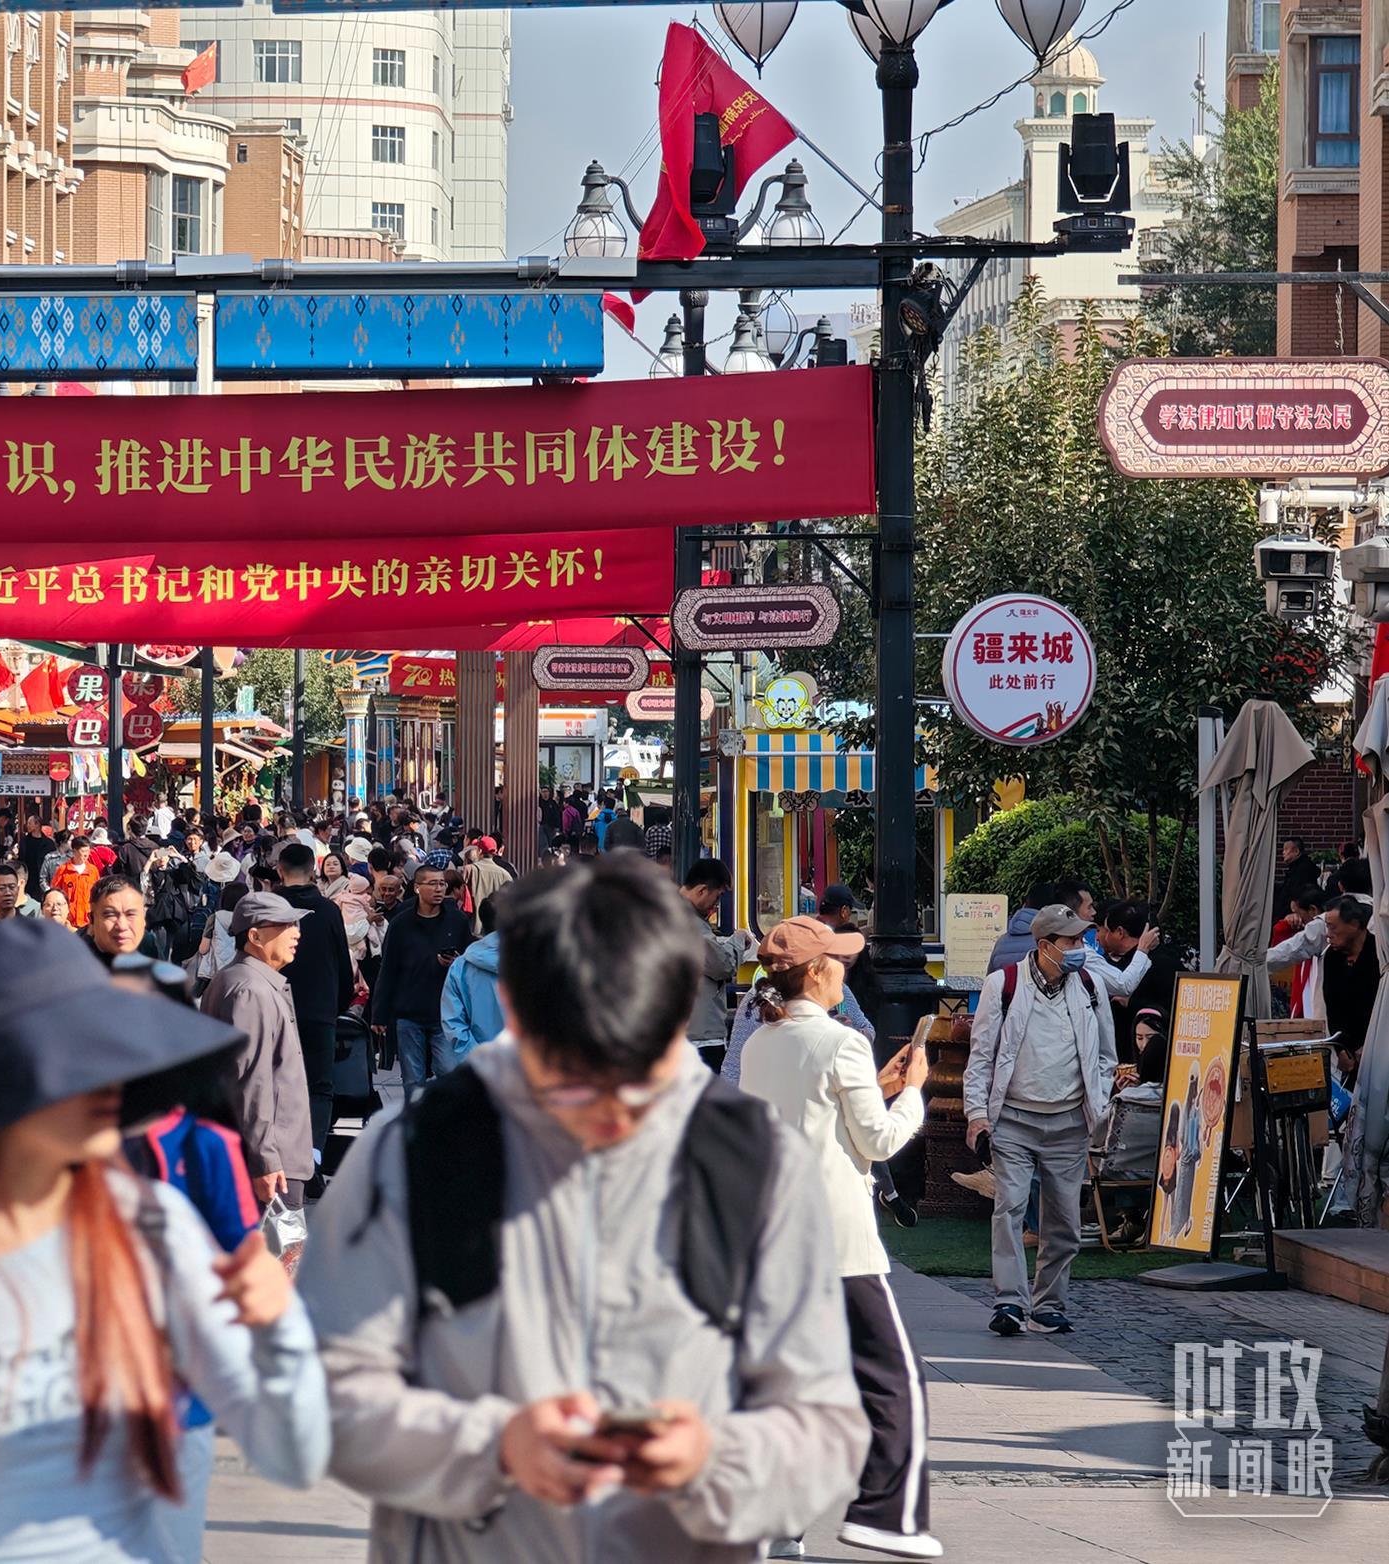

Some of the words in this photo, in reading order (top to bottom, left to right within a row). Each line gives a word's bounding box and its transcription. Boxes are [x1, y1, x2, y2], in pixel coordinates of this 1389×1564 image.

[973, 632, 1073, 664] 疆来城
[401, 664, 433, 686] 70
[989, 674, 1056, 690] 此处前行
